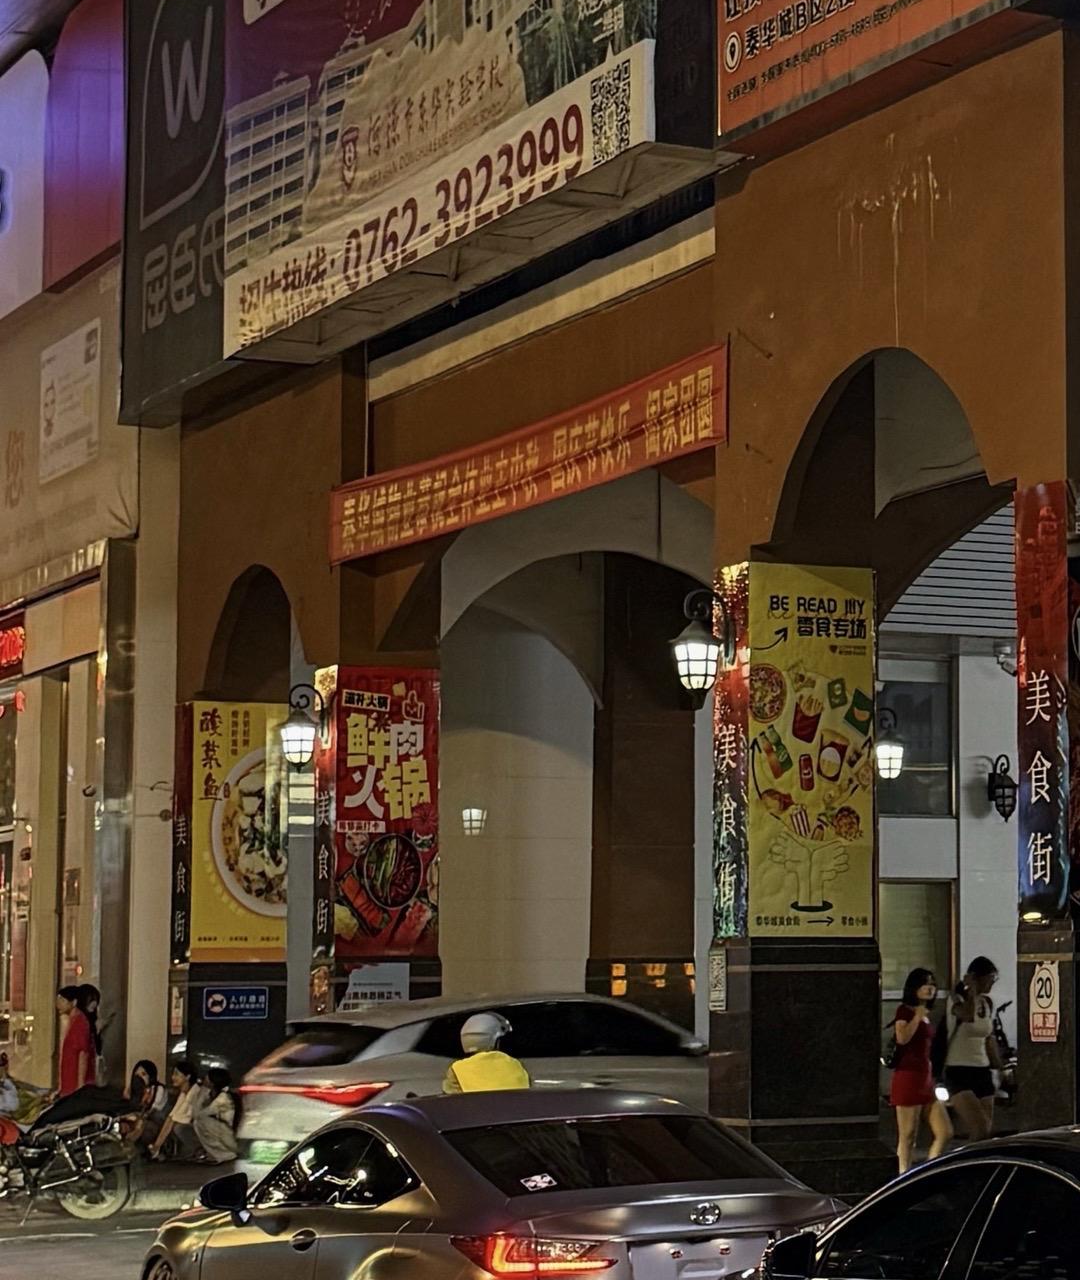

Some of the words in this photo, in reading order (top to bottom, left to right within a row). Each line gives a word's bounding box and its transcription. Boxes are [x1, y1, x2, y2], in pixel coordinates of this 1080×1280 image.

[161, 6, 213, 139] W
[769, 595, 789, 611] BE
[797, 597, 837, 613] READ
[344, 756, 431, 820] 火锅
[1025, 670, 1051, 887] 美食街
[174, 814, 188, 942] 美食街
[1036, 977, 1052, 999] 20
